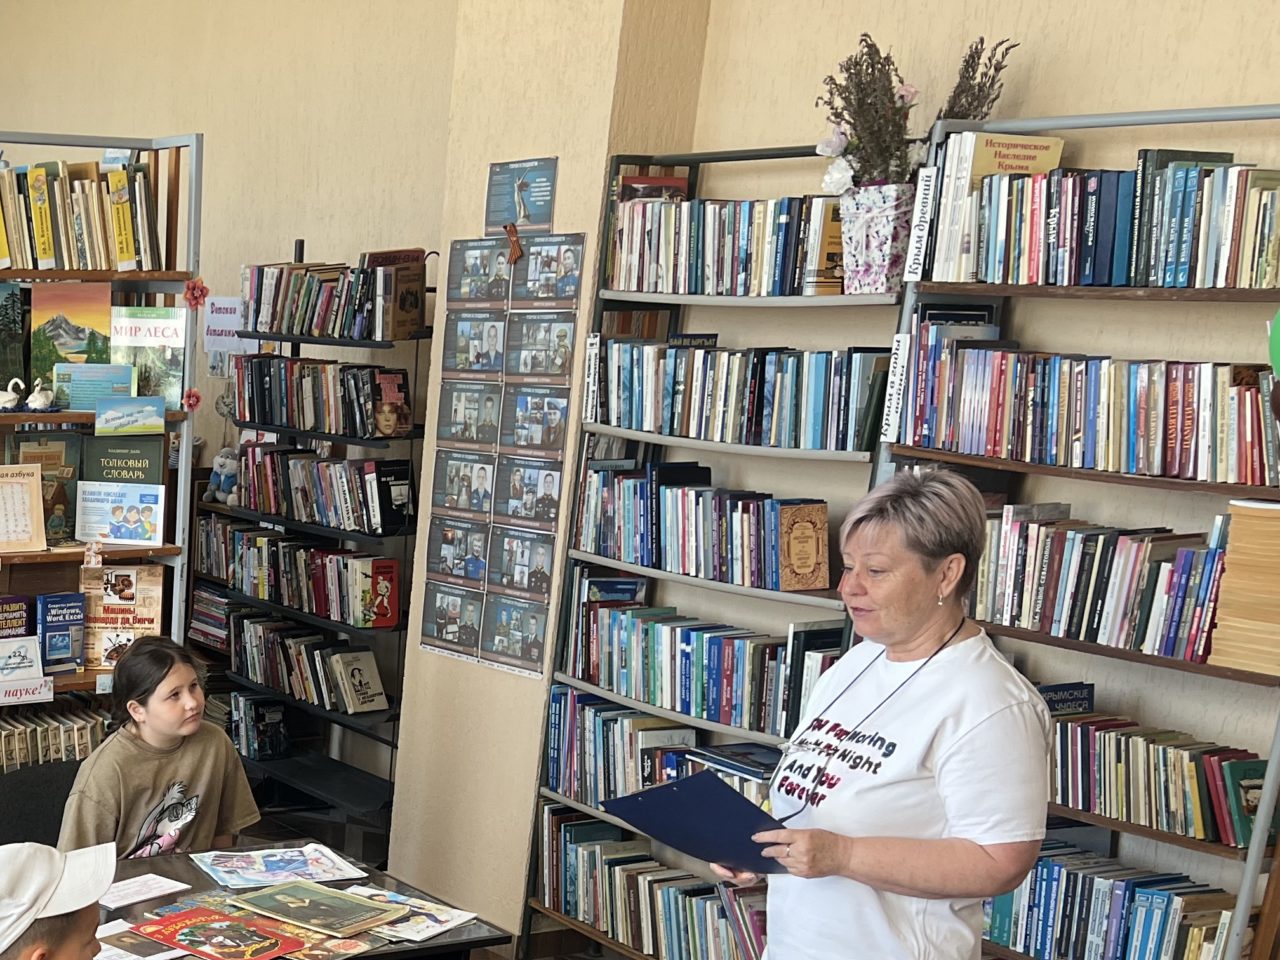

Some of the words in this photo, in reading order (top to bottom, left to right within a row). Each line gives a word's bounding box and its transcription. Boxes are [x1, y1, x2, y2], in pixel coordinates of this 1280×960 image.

[984, 138, 1050, 151] Историческое
[994, 150, 1037, 161] Наследие
[997, 161, 1030, 172] Крыма
[914, 174, 933, 232] древний
[1047, 207, 1060, 244] Крым
[907, 235, 924, 276] Крым
[113, 325, 142, 337] МИР
[143, 327, 180, 339] ЛЕСА
[890, 338, 902, 378] годы
[889, 380, 896, 389] в
[880, 392, 894, 439] Крым
[1167, 404, 1178, 448] ПАМЯТИ
[1149, 410, 1158, 447] ПАМЯТИ
[1181, 406, 1193, 449] ПАМЯТИ
[100, 458, 149, 468] ТОЛКОВЫЙ
[10, 470, 35, 480] азбука
[103, 469, 145, 480] СЛОВАРЬ
[1039, 536, 1052, 584] СЕВАСТОПОЛЬ
[2, 602, 27, 612] РАЗВИТЬ
[102, 605, 136, 615] Машины
[1034, 585, 1045, 613] РОДНОЙ
[65, 612, 84, 620] Excel
[120, 616, 130, 626] да
[132, 614, 155, 625] Винчи
[3, 683, 43, 700] науке!
[1042, 689, 1089, 702] КРЫМСКИЕ
[1054, 700, 1089, 712] ЧУДЕСА
[836, 747, 882, 775] Night
[782, 758, 816, 780] And
[811, 765, 842, 789] You
[777, 775, 827, 808] Forever
[1048, 880, 1058, 927] ПРИКЛЮЧЕНИЕ
[1044, 926, 1053, 960] КРЫМСКОЕ
